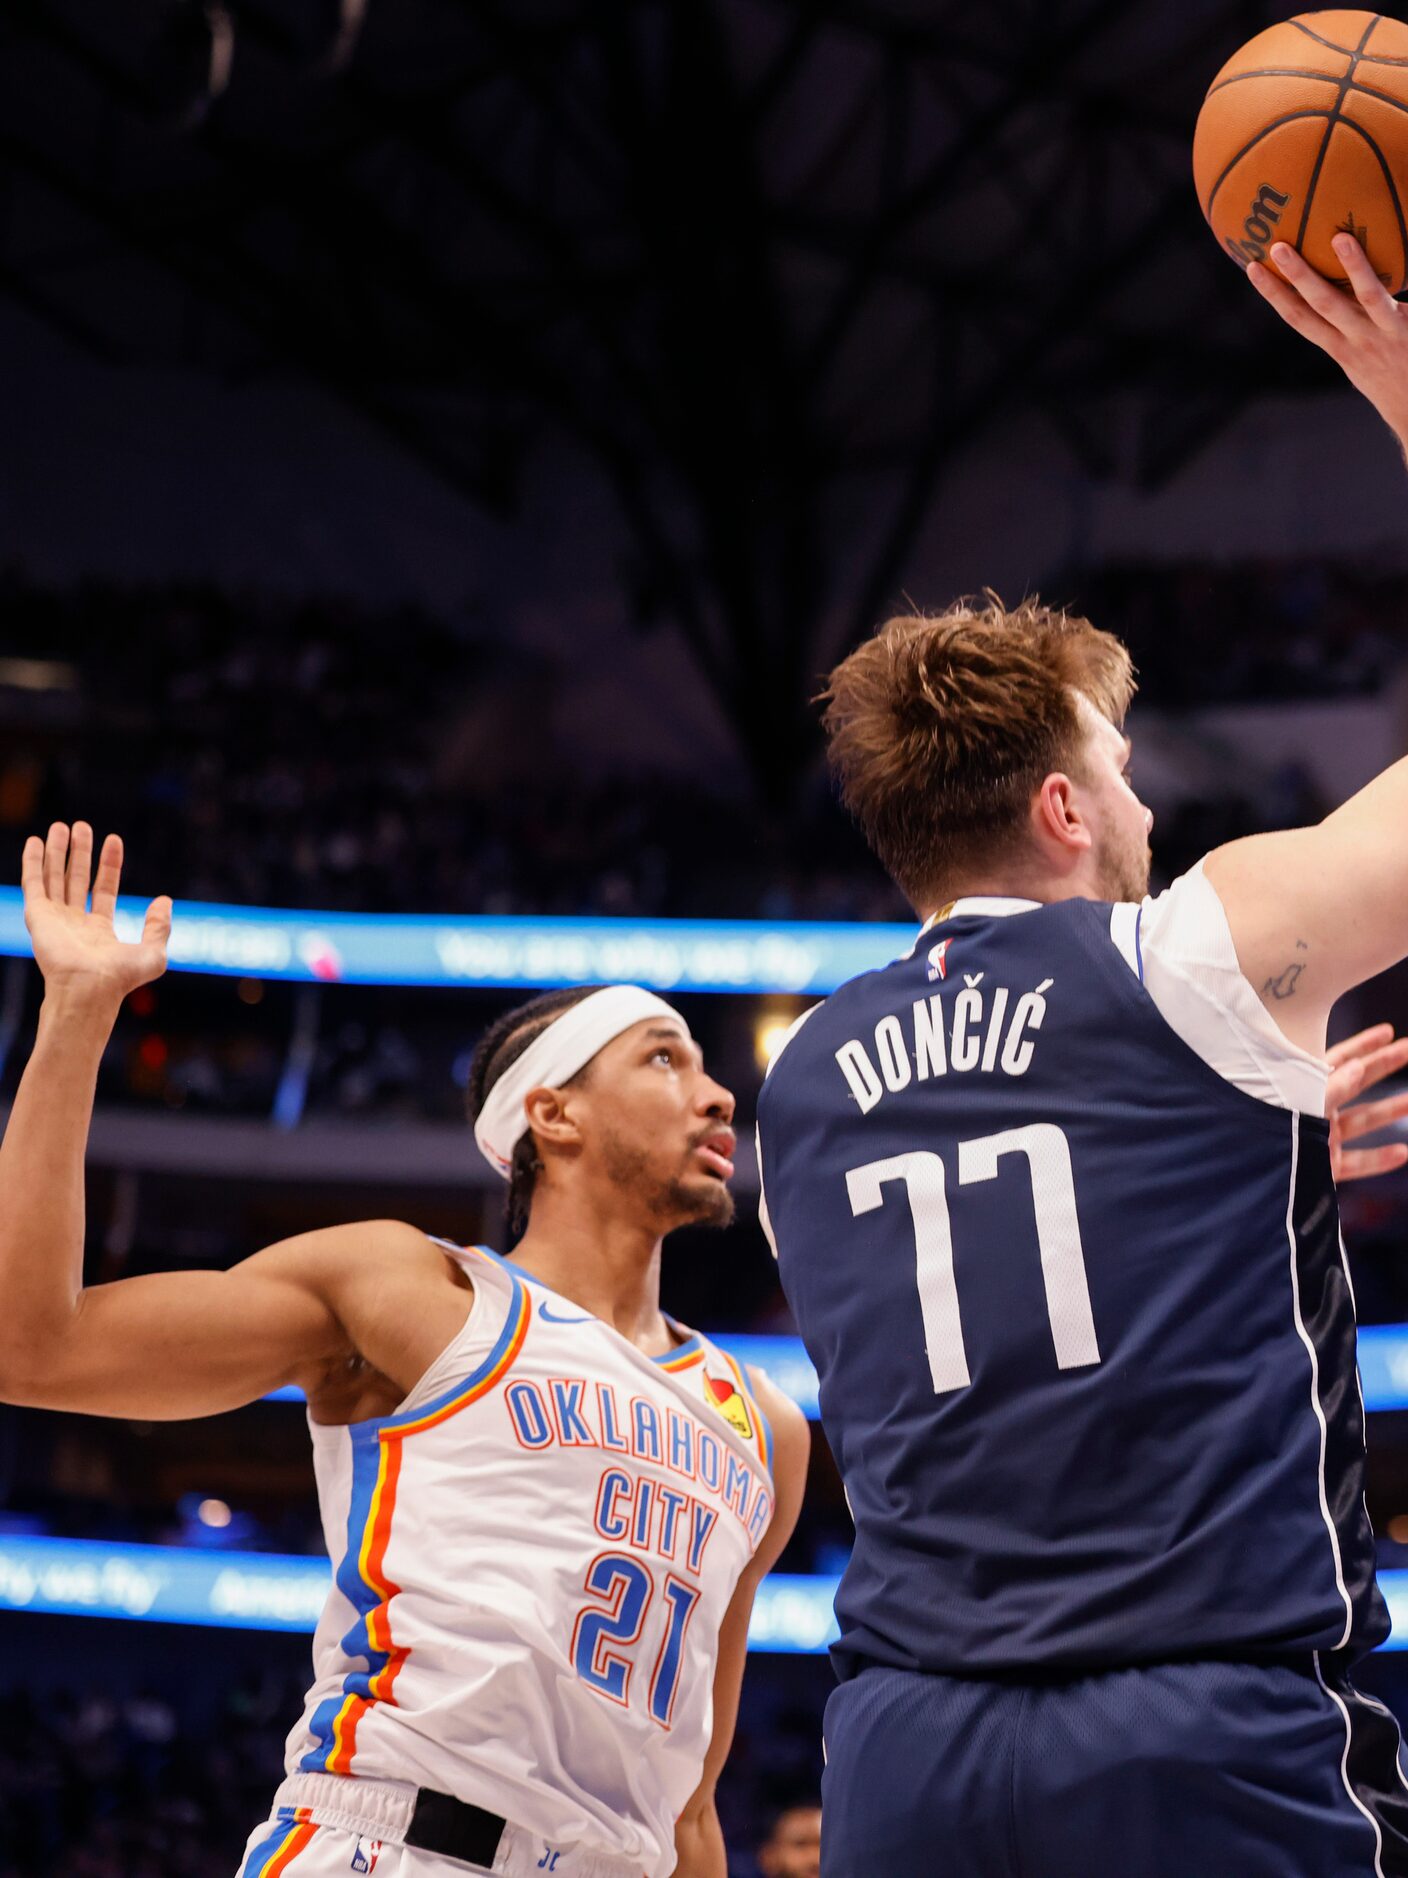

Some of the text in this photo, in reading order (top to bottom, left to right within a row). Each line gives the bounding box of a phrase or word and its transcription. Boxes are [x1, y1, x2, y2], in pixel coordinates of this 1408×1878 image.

[835, 972, 1054, 1115] DONČIĆ
[846, 1123, 1101, 1394] 77
[504, 1378, 775, 1557] OKLAHOMA
[594, 1467, 719, 1576] CITY
[570, 1551, 701, 1731] 21
